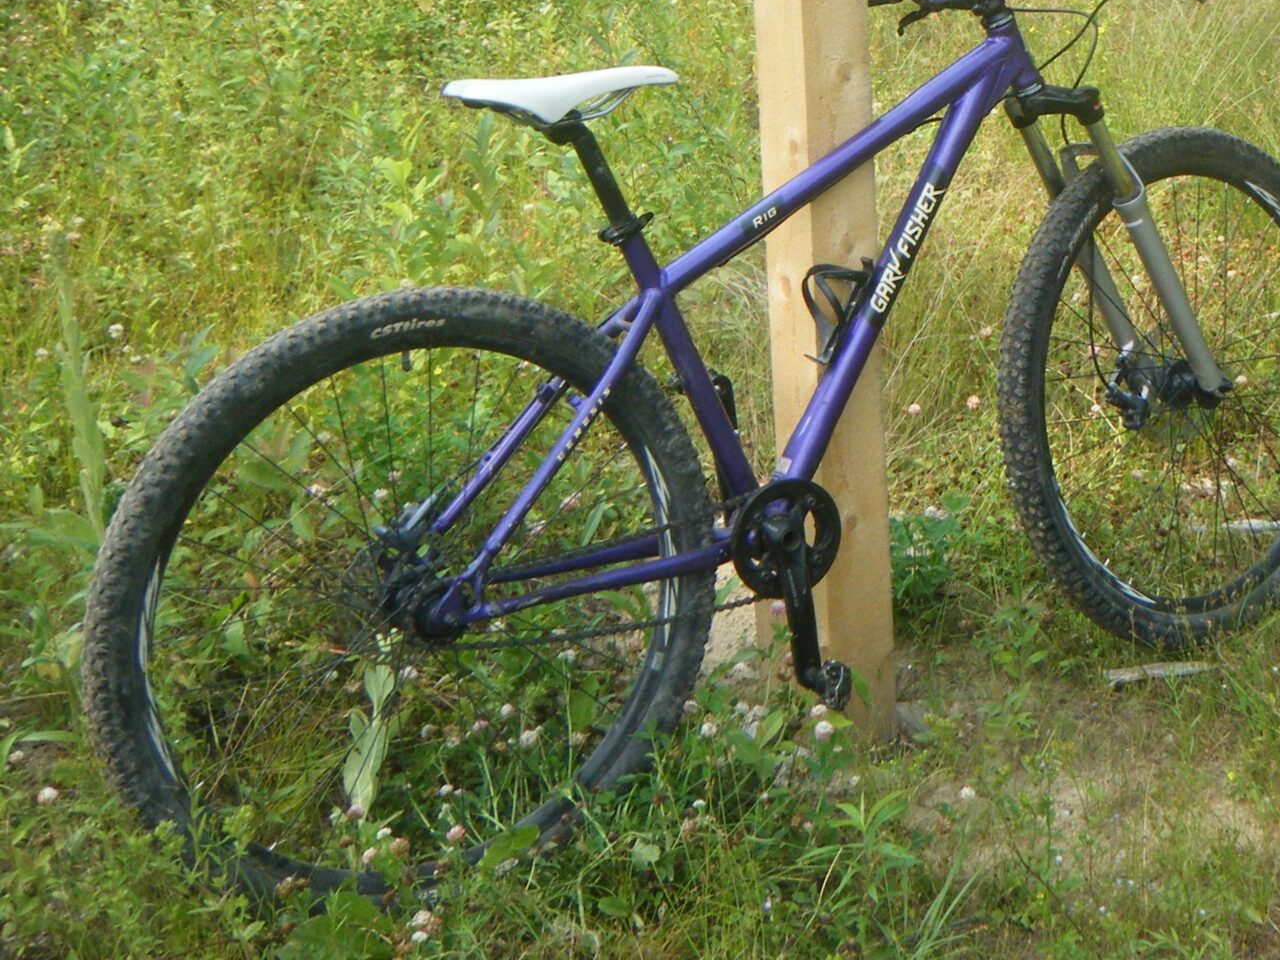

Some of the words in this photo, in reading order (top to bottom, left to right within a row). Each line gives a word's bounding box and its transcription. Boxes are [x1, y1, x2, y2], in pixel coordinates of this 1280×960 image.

[752, 206, 778, 229] RIG
[869, 246, 907, 313] GARY
[896, 181, 946, 259] FISHER
